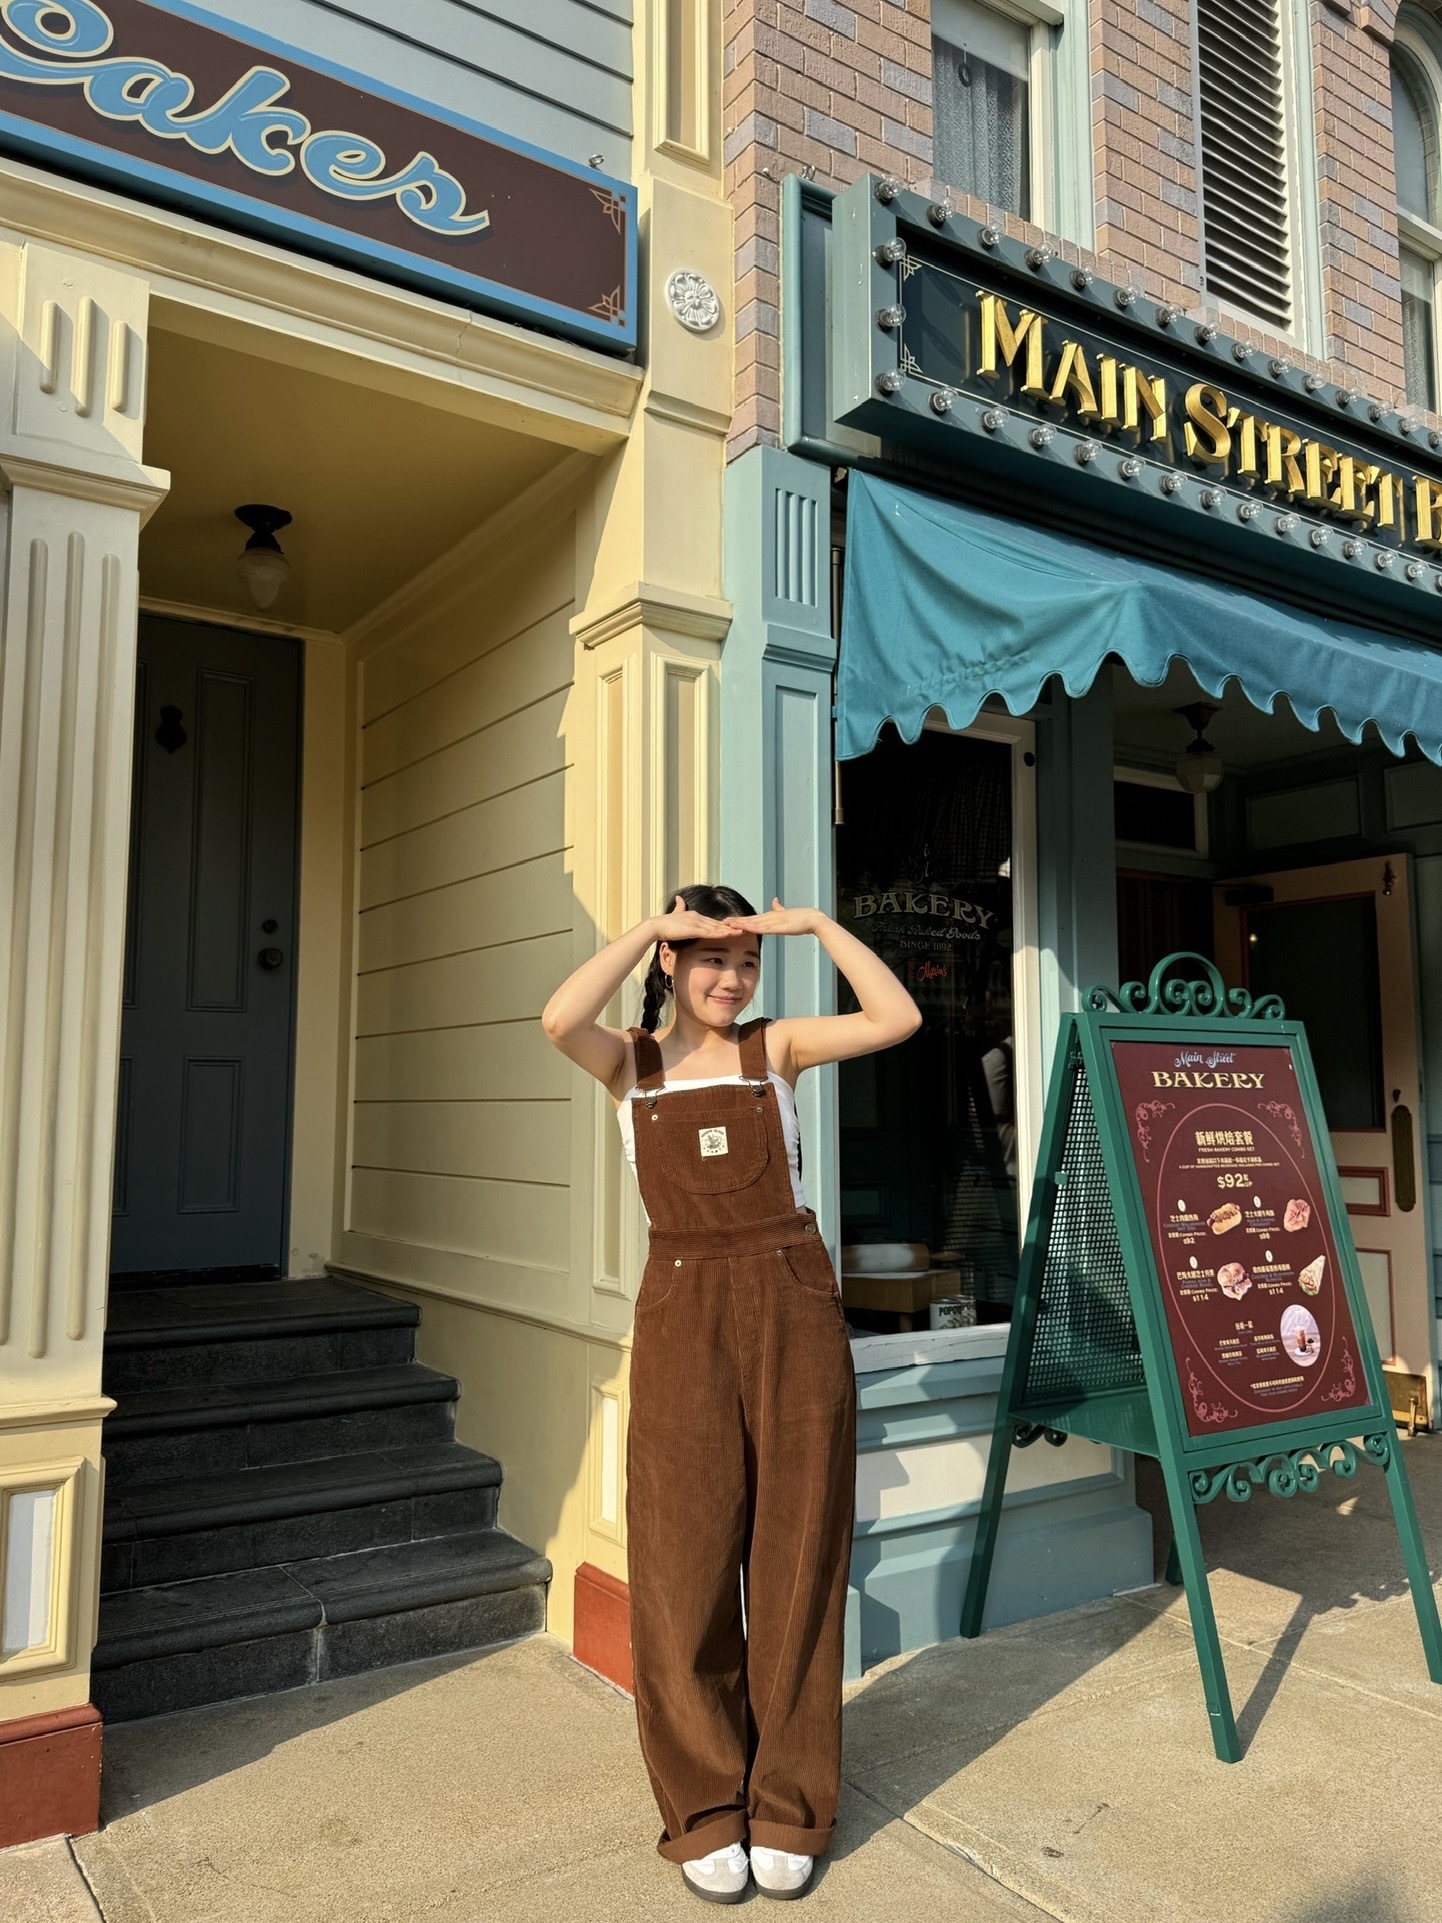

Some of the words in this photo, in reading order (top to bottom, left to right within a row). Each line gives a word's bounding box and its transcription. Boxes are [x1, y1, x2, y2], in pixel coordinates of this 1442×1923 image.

[975, 290, 1168, 442] MAIN
[1184, 383, 1404, 527] STREET
[853, 891, 994, 930] BAKERY
[906, 924, 945, 937] Baked
[945, 927, 982, 941] Goods
[932, 943, 952, 952] 1892
[1174, 1051, 1204, 1068] Main
[1205, 1050, 1236, 1069] Street
[1151, 1071, 1265, 1089] BAKERY
[1217, 1173, 1244, 1189] $92
[1183, 1237, 1195, 1245] $92
[1192, 1294, 1209, 1302] $114
[1268, 1287, 1284, 1295] $114
